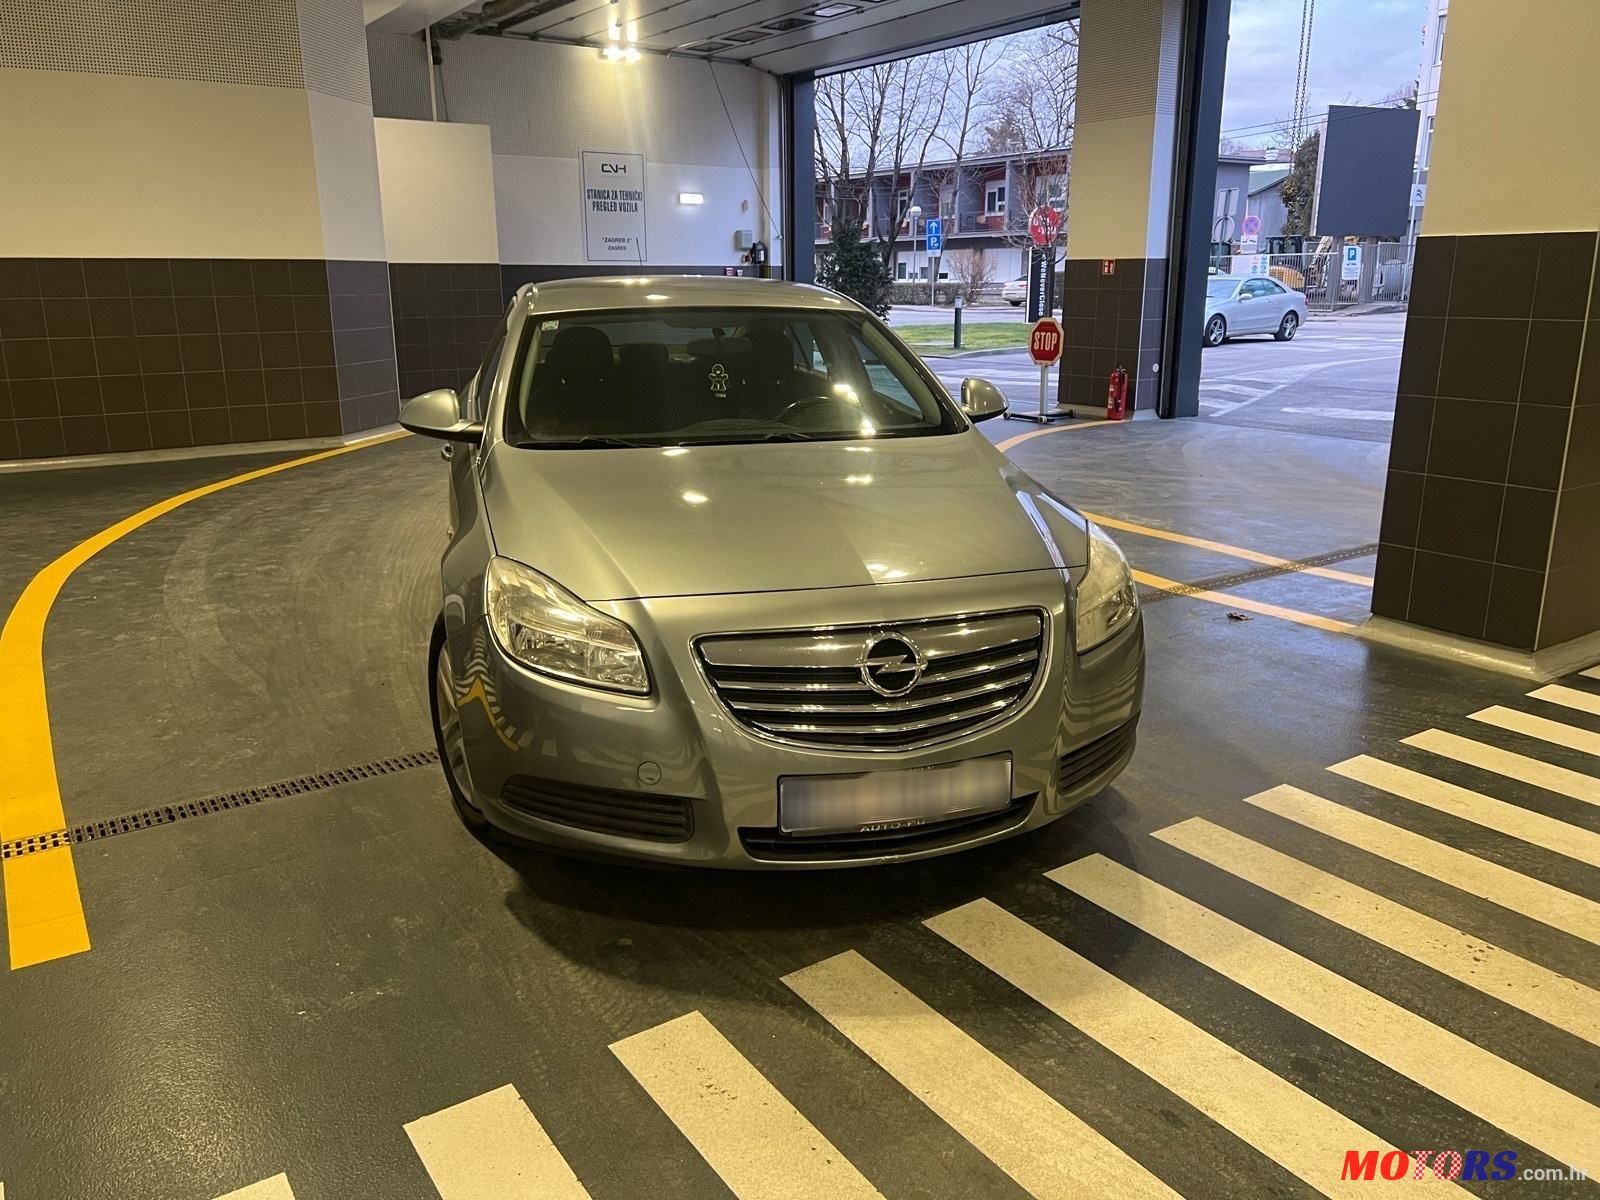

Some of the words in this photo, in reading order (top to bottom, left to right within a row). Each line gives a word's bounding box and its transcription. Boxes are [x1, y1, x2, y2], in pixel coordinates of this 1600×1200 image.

[586, 188, 611, 200] STANICA
[611, 189, 618, 200] ZA
[592, 201, 618, 212] PREGLED
[619, 201, 639, 213] VOZILA
[1033, 331, 1058, 352] STOP
